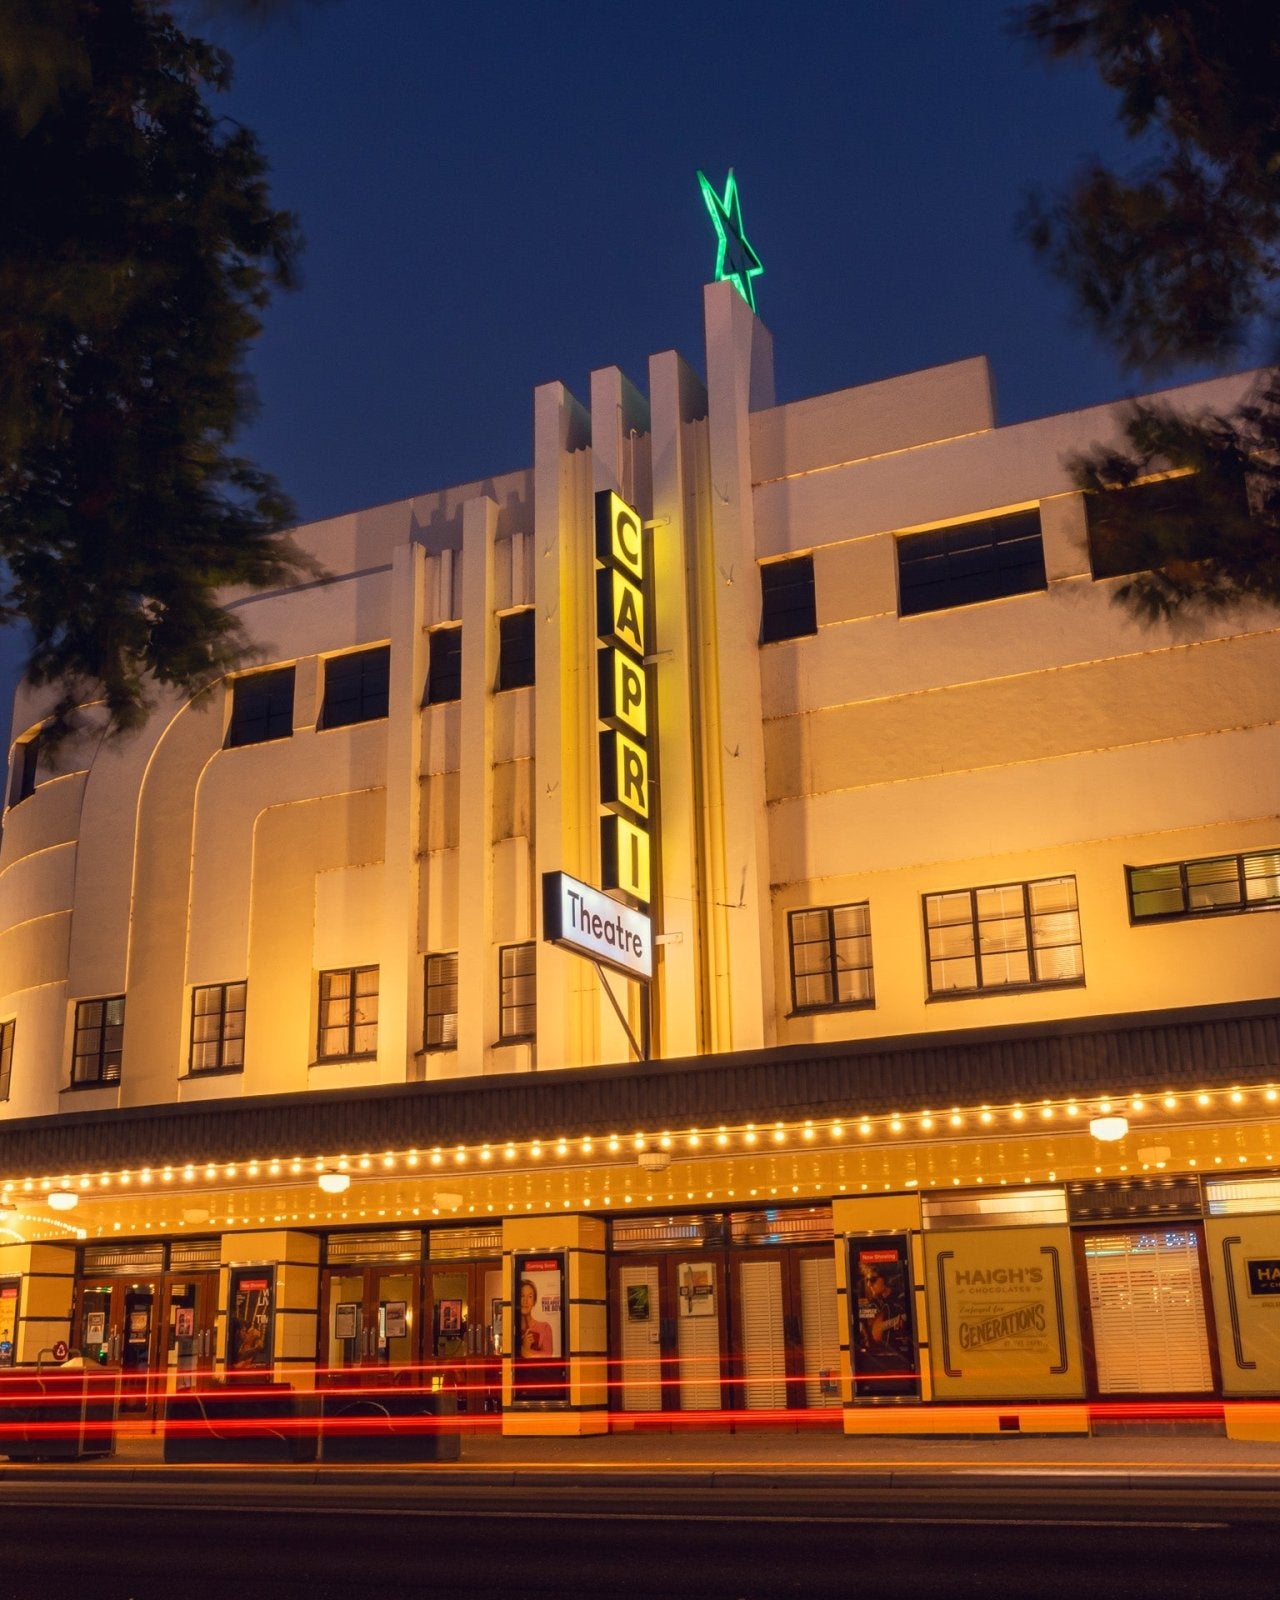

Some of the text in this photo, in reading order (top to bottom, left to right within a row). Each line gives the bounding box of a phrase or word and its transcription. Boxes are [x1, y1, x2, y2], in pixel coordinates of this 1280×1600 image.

[616, 510, 646, 889] CAPRI
[567, 889, 643, 958] Theatre
[955, 1267, 1043, 1285] HAIGH'S
[959, 1304, 1046, 1349] GENERATIONS
